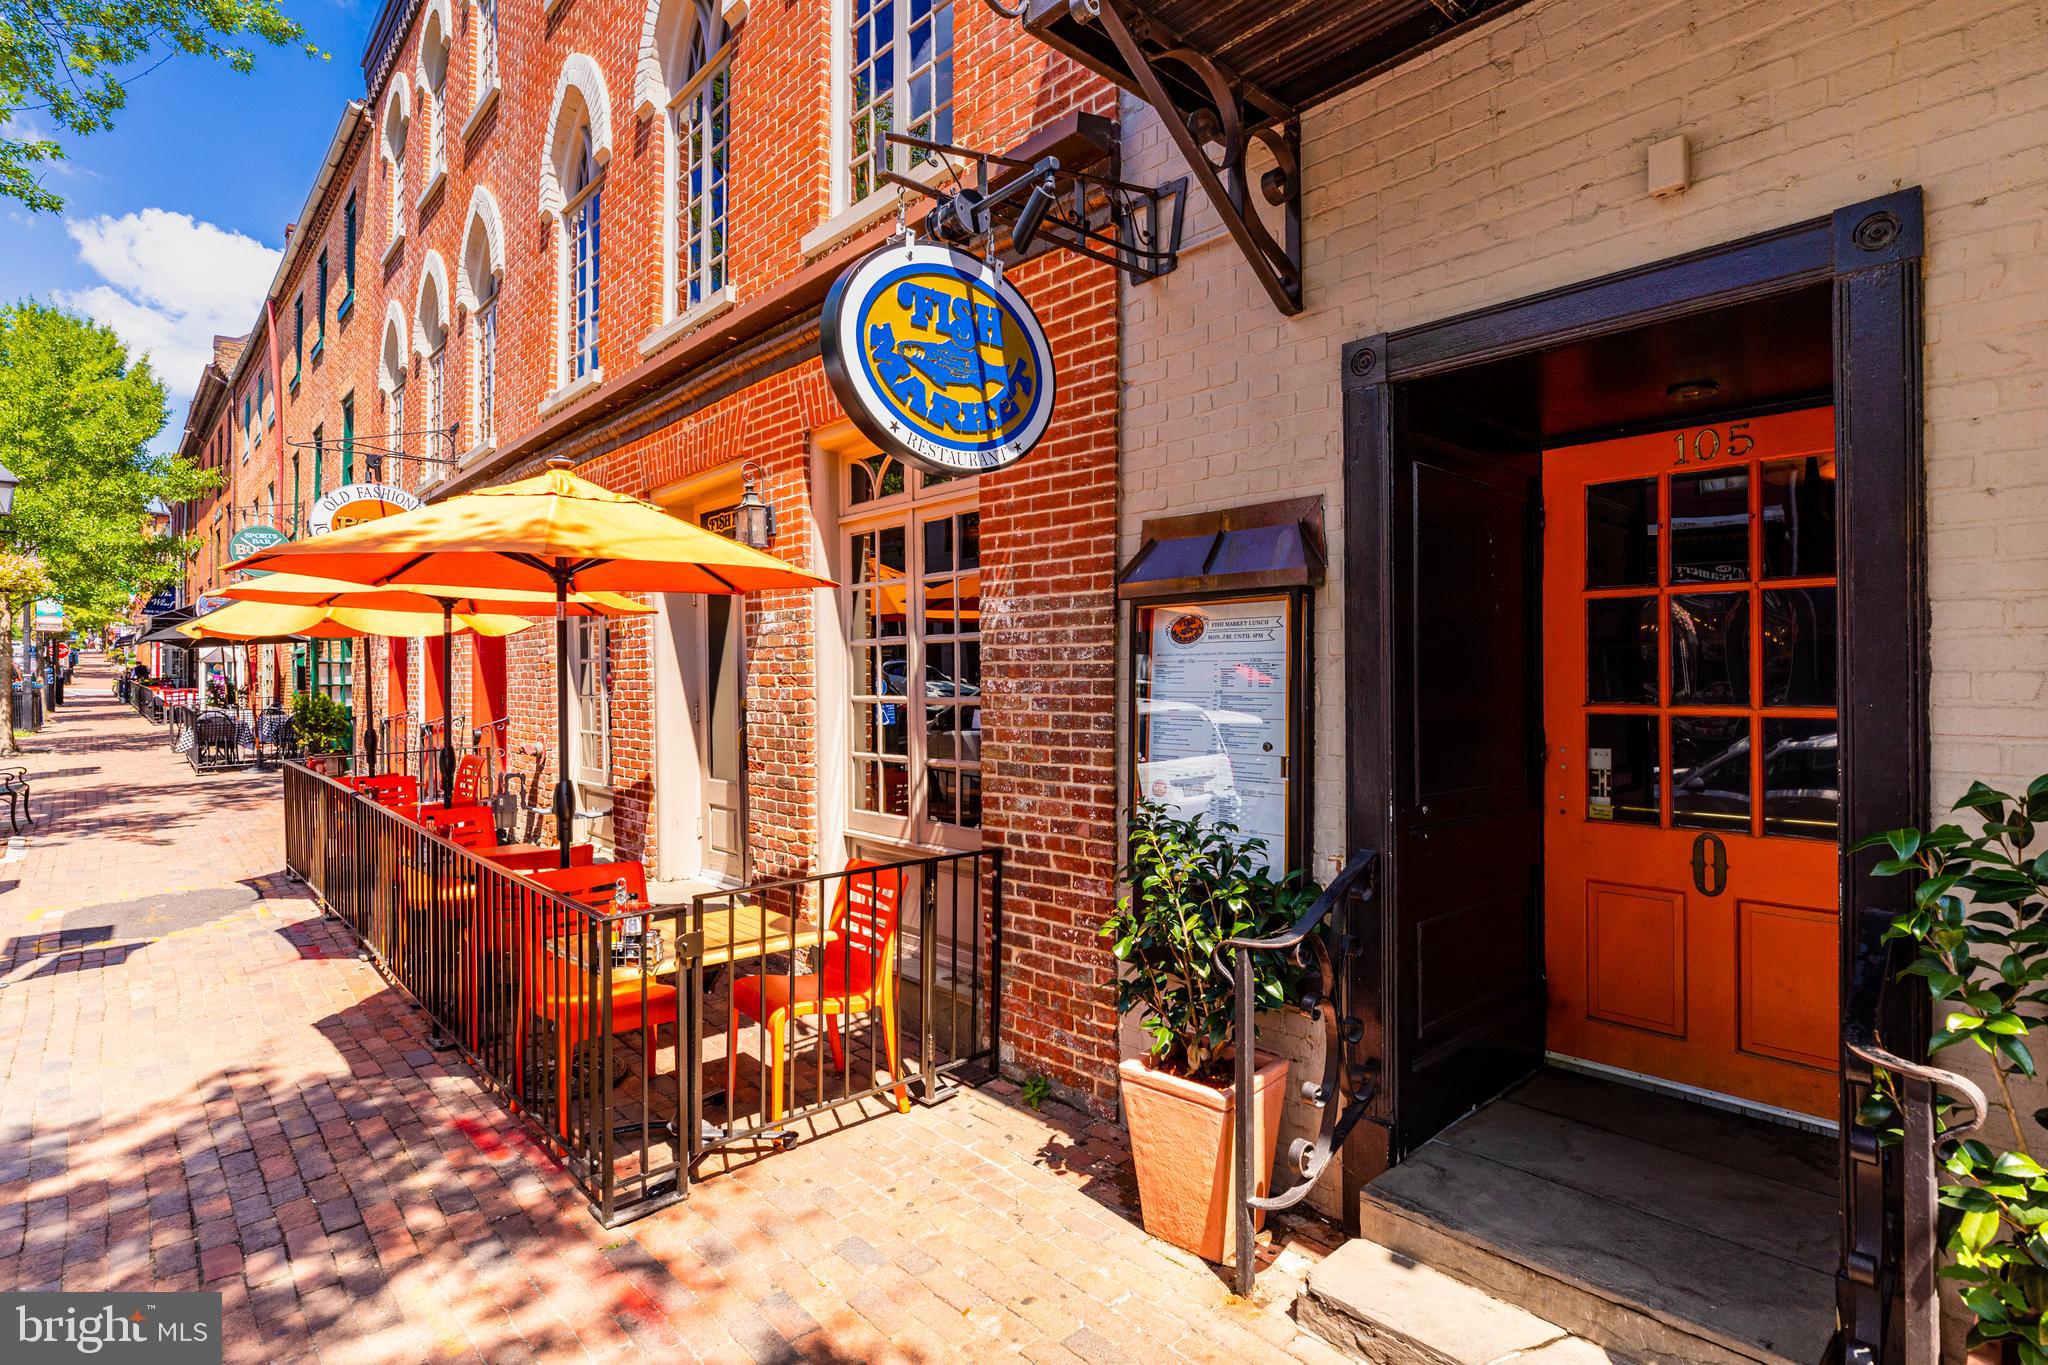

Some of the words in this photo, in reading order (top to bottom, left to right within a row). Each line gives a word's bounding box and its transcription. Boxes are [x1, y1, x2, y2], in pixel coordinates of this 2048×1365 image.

[897, 281, 1004, 352] FISH
[869, 322, 1032, 434] MARKET
[906, 431, 1009, 467] RESTAURANT
[1673, 422, 1754, 465] 105
[323, 490, 350, 512] OLD
[244, 532, 279, 540] SPORTS
[708, 513, 731, 532] FISH
[48, 646, 68, 655] SOP
